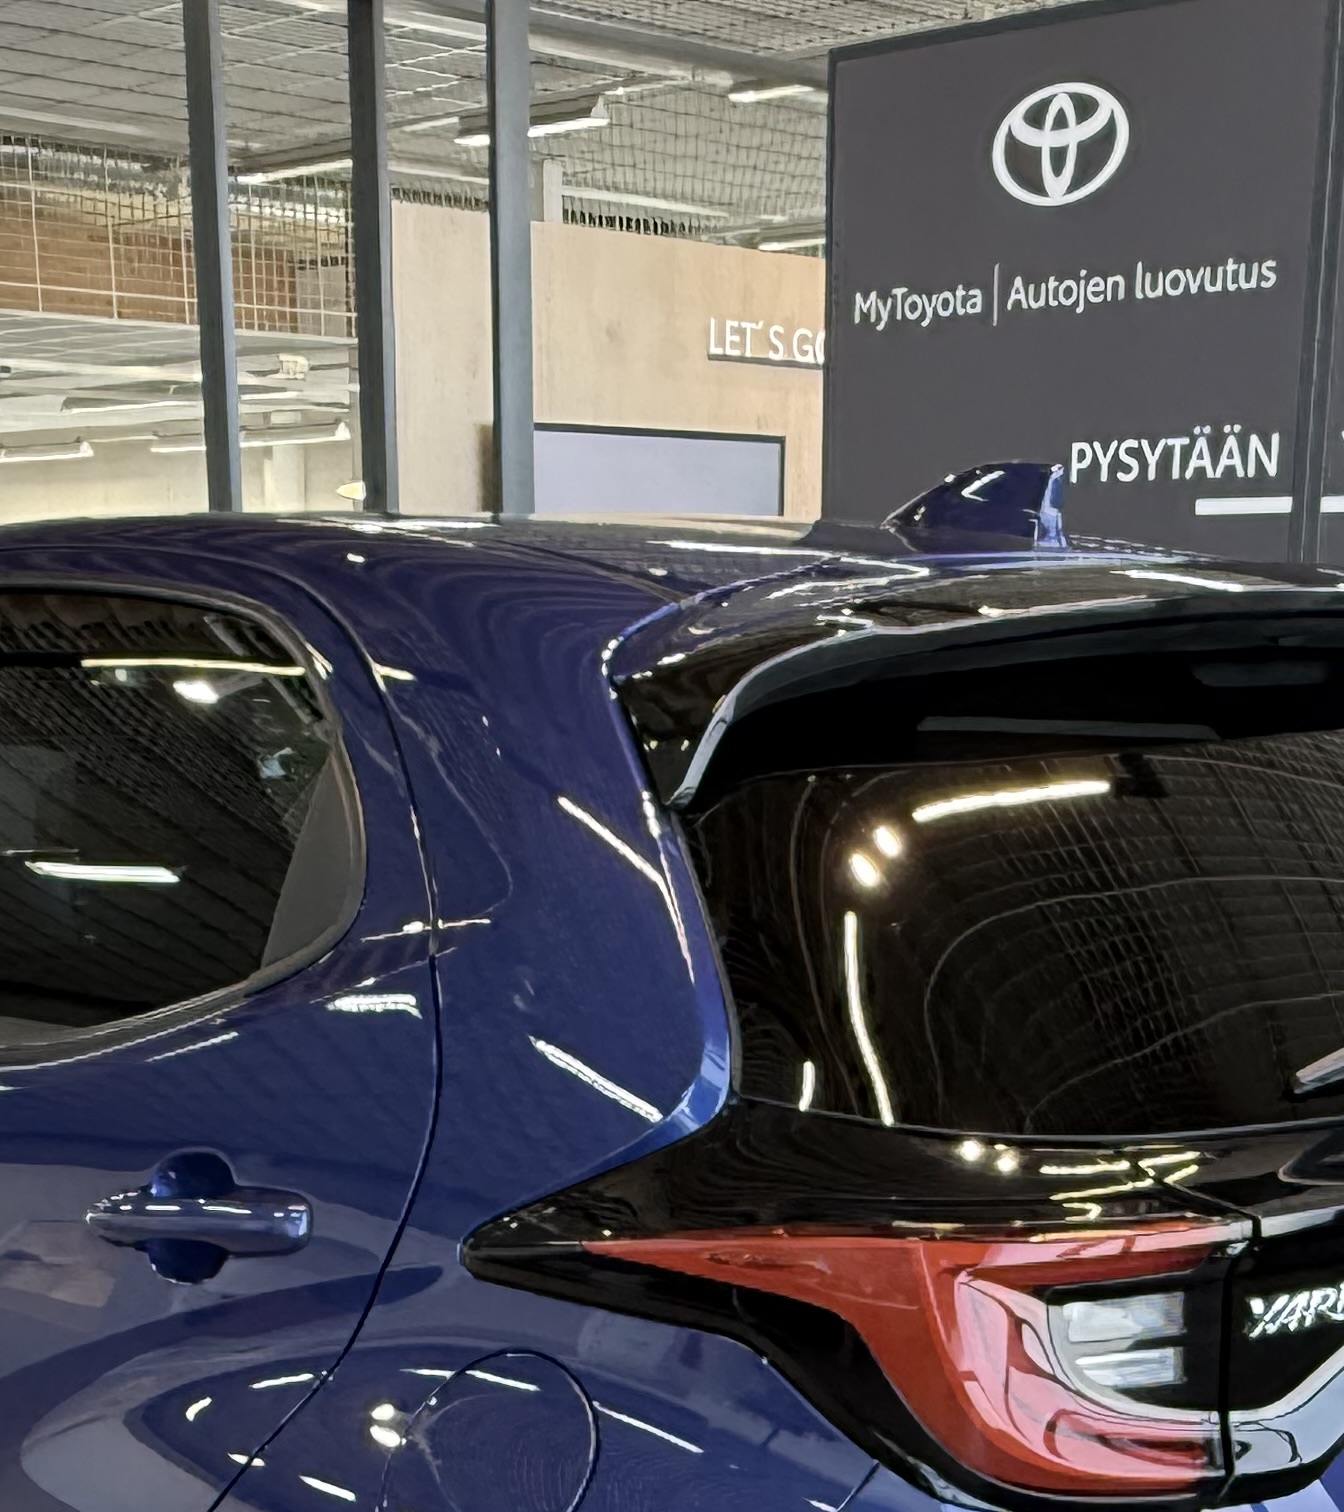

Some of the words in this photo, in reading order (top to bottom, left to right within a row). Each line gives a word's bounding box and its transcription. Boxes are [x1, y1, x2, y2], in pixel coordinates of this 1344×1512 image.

[854, 285, 983, 331] MyToyota
[1007, 269, 1126, 314] Autojen
[1135, 257, 1277, 300] luovutus
[1069, 423, 1280, 484] PYSYTÄÄN
